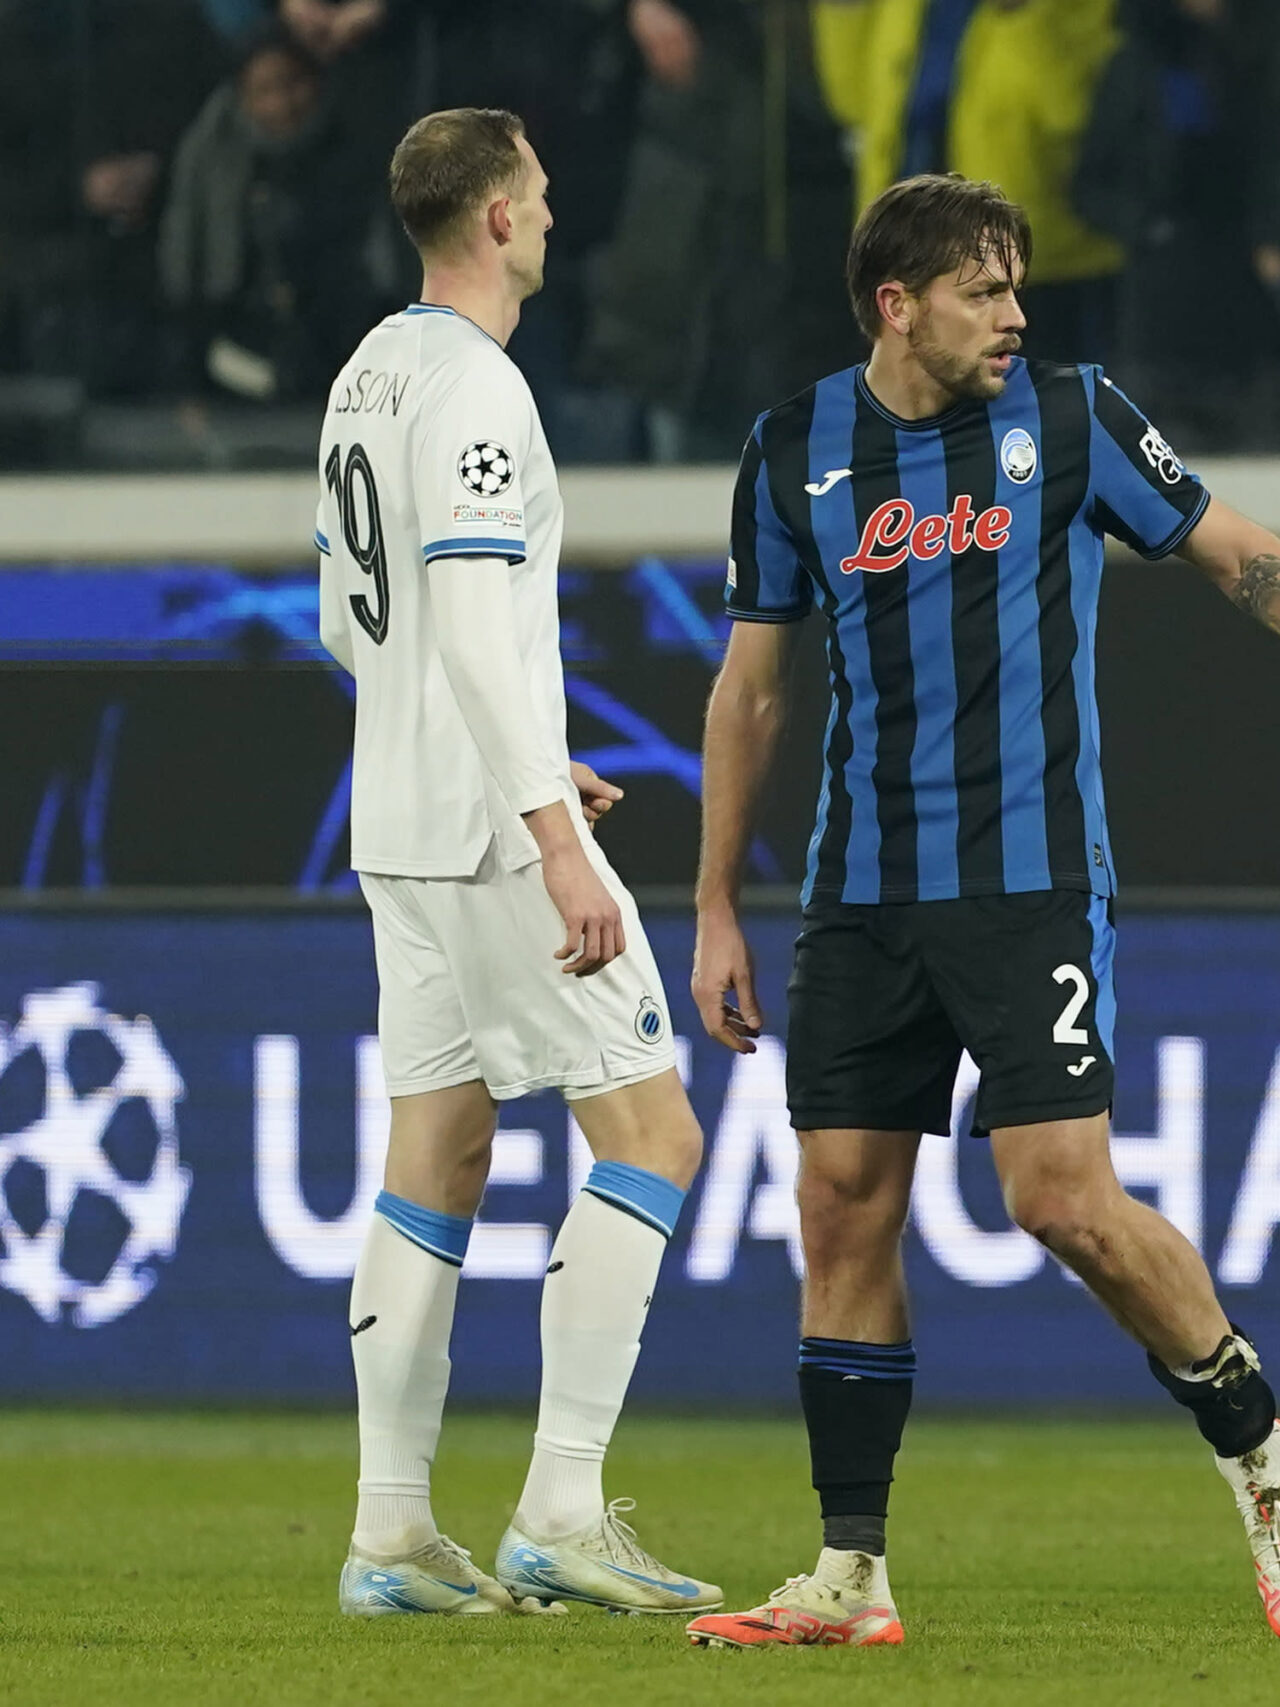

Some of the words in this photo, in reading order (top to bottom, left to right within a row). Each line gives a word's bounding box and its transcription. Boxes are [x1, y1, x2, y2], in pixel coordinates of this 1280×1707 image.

[325, 442, 390, 646] 19
[454, 510, 523, 520] FOUNDATION
[839, 494, 1012, 575] Lete
[1052, 963, 1089, 1045] 2
